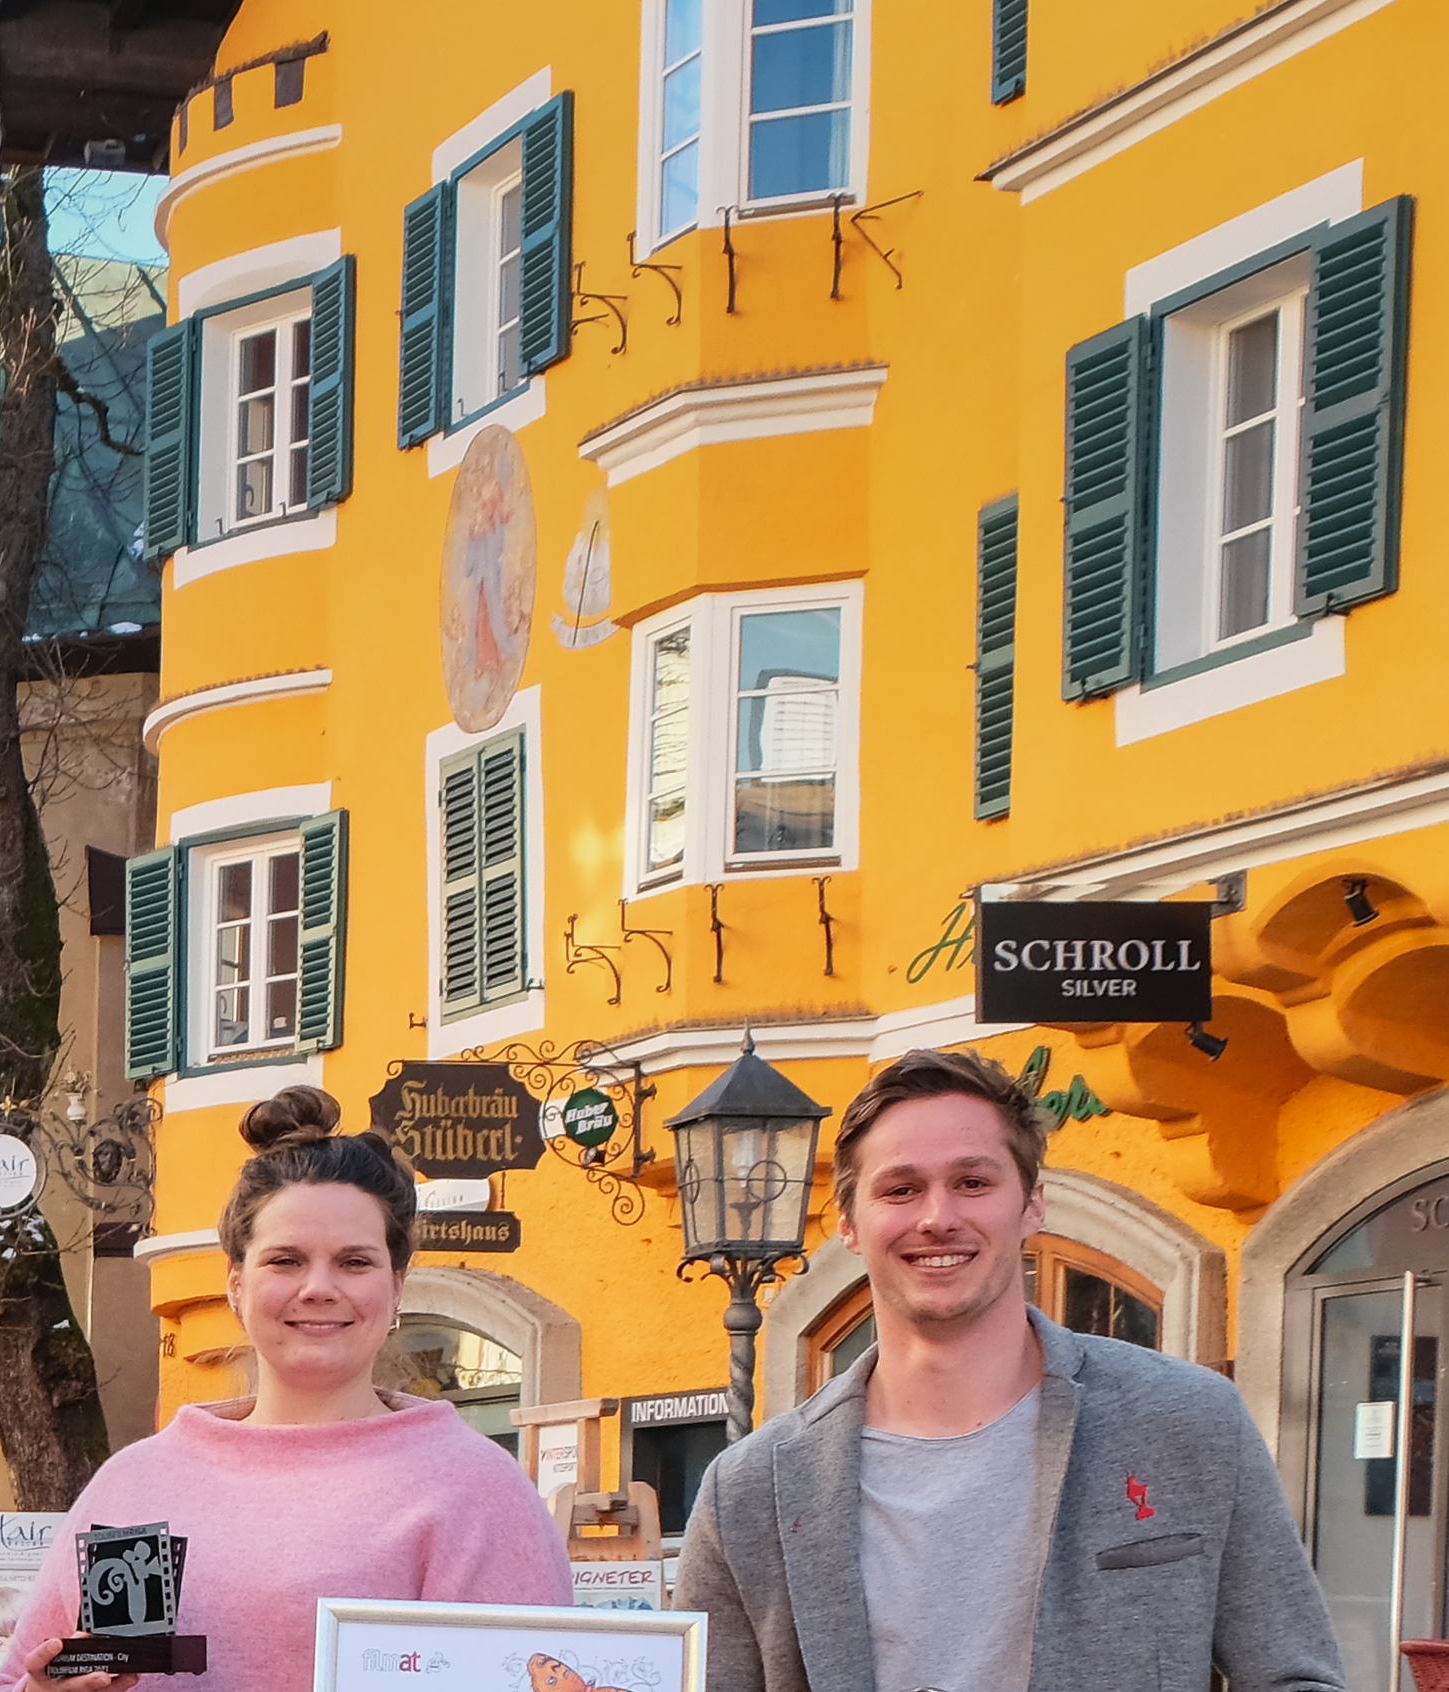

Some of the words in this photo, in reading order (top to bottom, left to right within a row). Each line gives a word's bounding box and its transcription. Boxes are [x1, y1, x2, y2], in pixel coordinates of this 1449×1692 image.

[993, 939, 1201, 972] SCHROLL
[1061, 978, 1137, 997] SILVER
[394, 1080, 519, 1120] Huberbräu
[565, 1102, 609, 1123] Huber
[575, 1114, 613, 1135] Bräu
[414, 1220, 510, 1245] irtshaus
[571, 1570, 656, 1585] IGNETER
[362, 1648, 421, 1673] filmat
